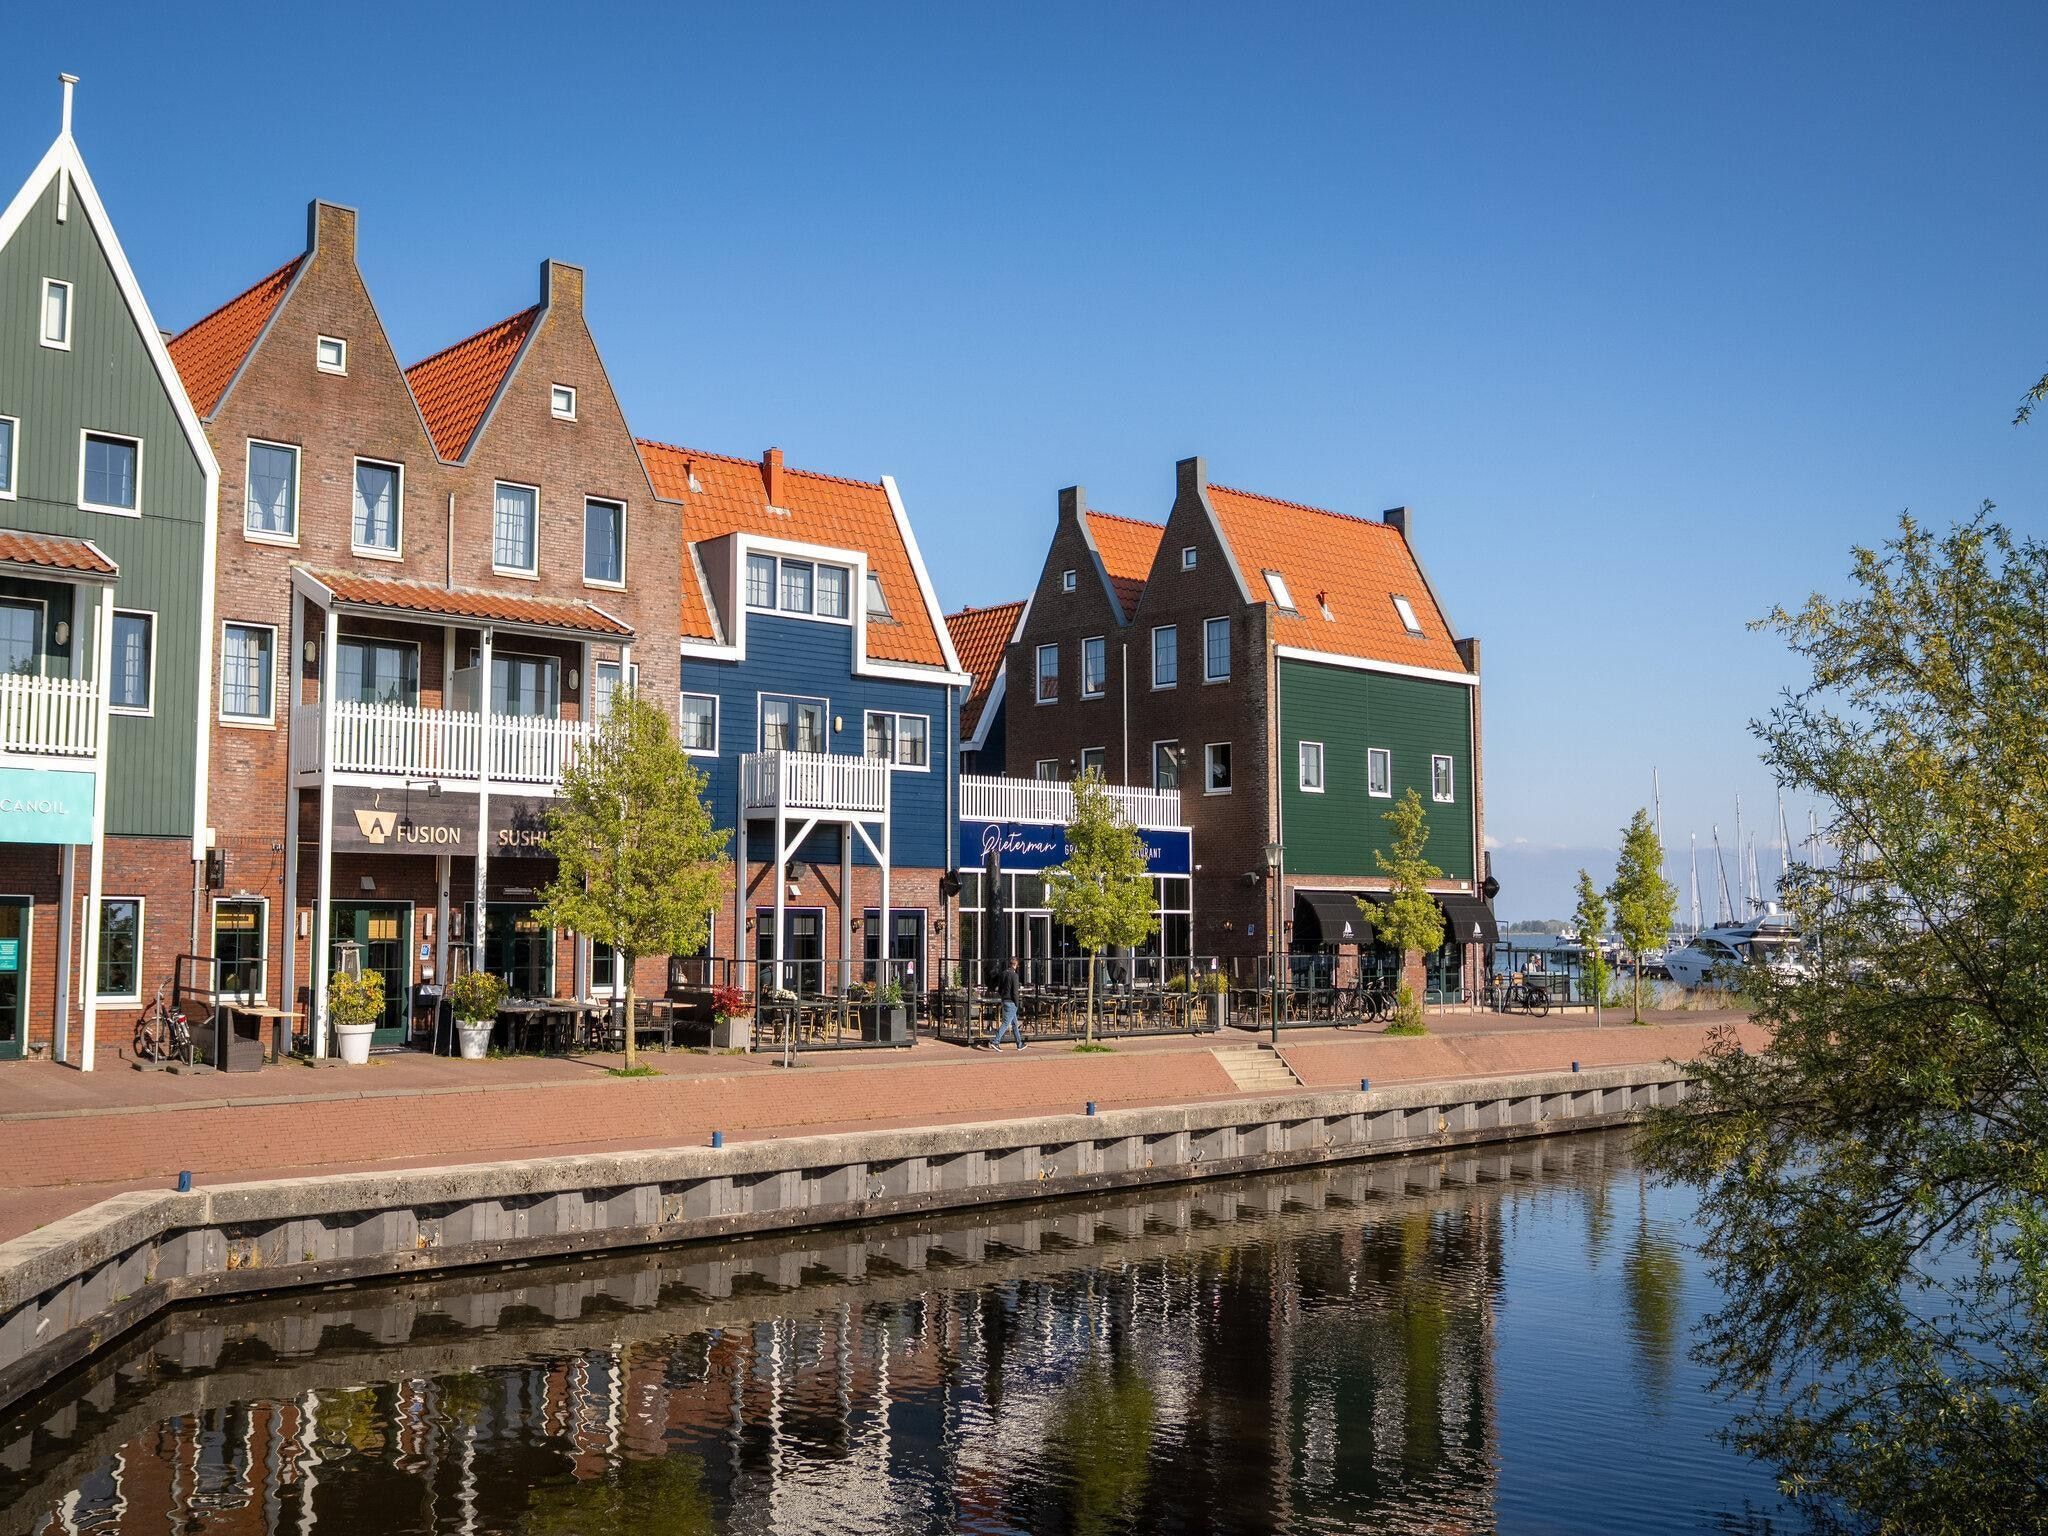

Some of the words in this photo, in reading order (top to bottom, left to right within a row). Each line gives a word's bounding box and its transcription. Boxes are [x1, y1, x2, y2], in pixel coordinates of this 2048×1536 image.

[371, 817, 385, 835] A
[397, 826, 461, 844] FUSION
[980, 824, 1057, 866] Pieterman
